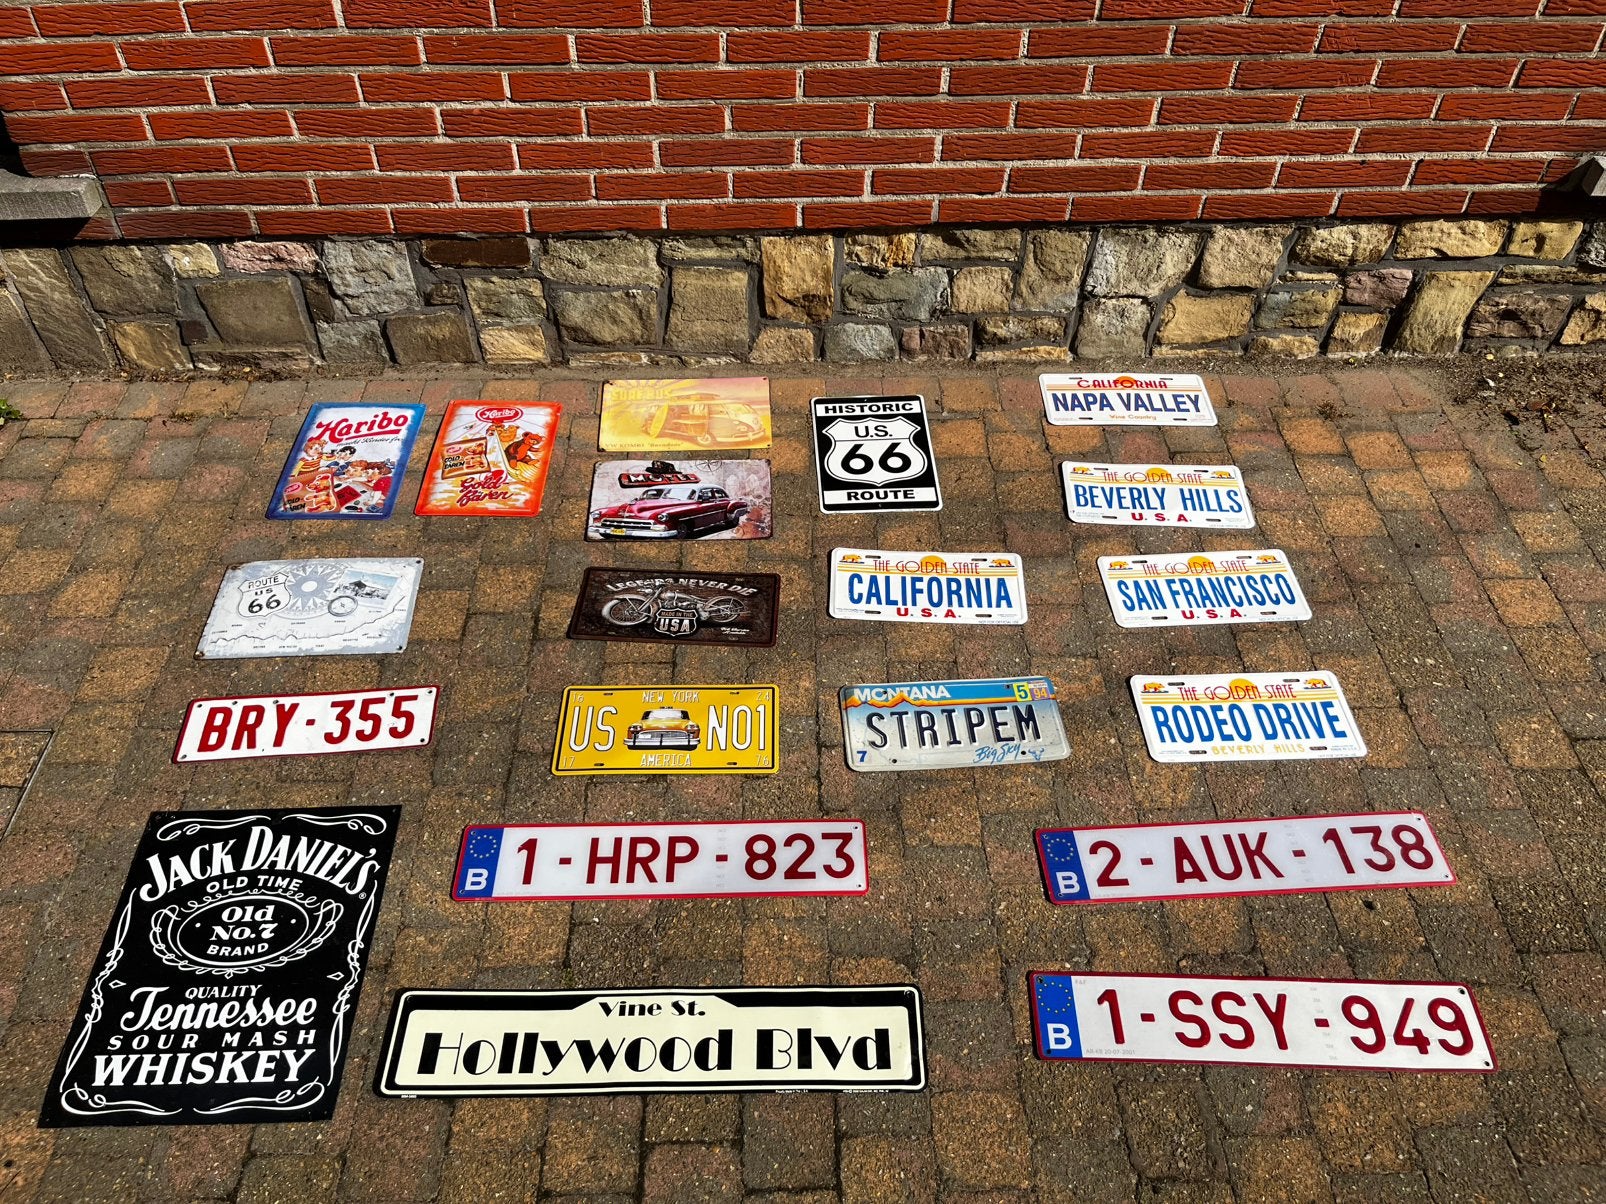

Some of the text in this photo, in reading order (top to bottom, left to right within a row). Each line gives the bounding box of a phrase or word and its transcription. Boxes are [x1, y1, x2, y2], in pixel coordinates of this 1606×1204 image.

[1077, 379, 1168, 389] CALIFORNIA
[824, 402, 914, 414] HISTORIC
[1051, 392, 1201, 413] NAPA VALLEY
[307, 411, 409, 444] Haribo
[854, 424, 893, 438] U.S.
[841, 442, 912, 475] 66
[1102, 471, 1204, 485] THE GOLDEN STATE
[846, 489, 916, 501] ROUTE
[1073, 484, 1243, 514] BEVERLY HILLS
[873, 559, 981, 574] THE GOLDEN STATE
[1142, 559, 1250, 576] THE GOLDEN STATE
[248, 575, 279, 589] ROUTE
[606, 578, 758, 596] LEGENDS NEVER DIE
[254, 588, 273, 596] US
[848, 573, 1013, 609] CALIFORNIA
[1117, 573, 1296, 612] SAN FRANCISCO
[248, 594, 281, 614] 66
[659, 618, 690, 632] USA
[572, 692, 584, 702] 16
[642, 691, 700, 703] NEW YORK
[756, 691, 770, 701] 24
[853, 685, 951, 701] MONTANA
[1016, 684, 1029, 700] 5
[1033, 687, 1048, 699] 94
[1177, 684, 1297, 701] THE GOLDEN STATE
[569, 706, 618, 751] US
[866, 704, 1041, 749] STRIPEM
[1150, 701, 1348, 743] RODEO DRIVE
[857, 750, 867, 762] 7
[973, 743, 1021, 764] Big Sky
[1211, 743, 1305, 756] BEVERLY HILLS
[563, 756, 575, 768] 17
[640, 753, 692, 767] AMERICA
[756, 755, 769, 767] 76
[139, 825, 381, 901] JACK DANIEL'S
[206, 875, 303, 893] OLD TIME
[465, 868, 489, 892] B
[1056, 871, 1080, 894] B
[221, 905, 275, 922] Old
[206, 942, 269, 957] BRAND
[185, 984, 262, 1000] QUALITY
[120, 986, 317, 1032] Tennessee
[598, 1000, 706, 1018] Vine St.
[107, 1029, 317, 1050] SOUR MASH
[1047, 1023, 1073, 1051] B
[416, 1027, 891, 1077] Hollywood Blvd
[91, 1049, 316, 1087] WHISKEY
